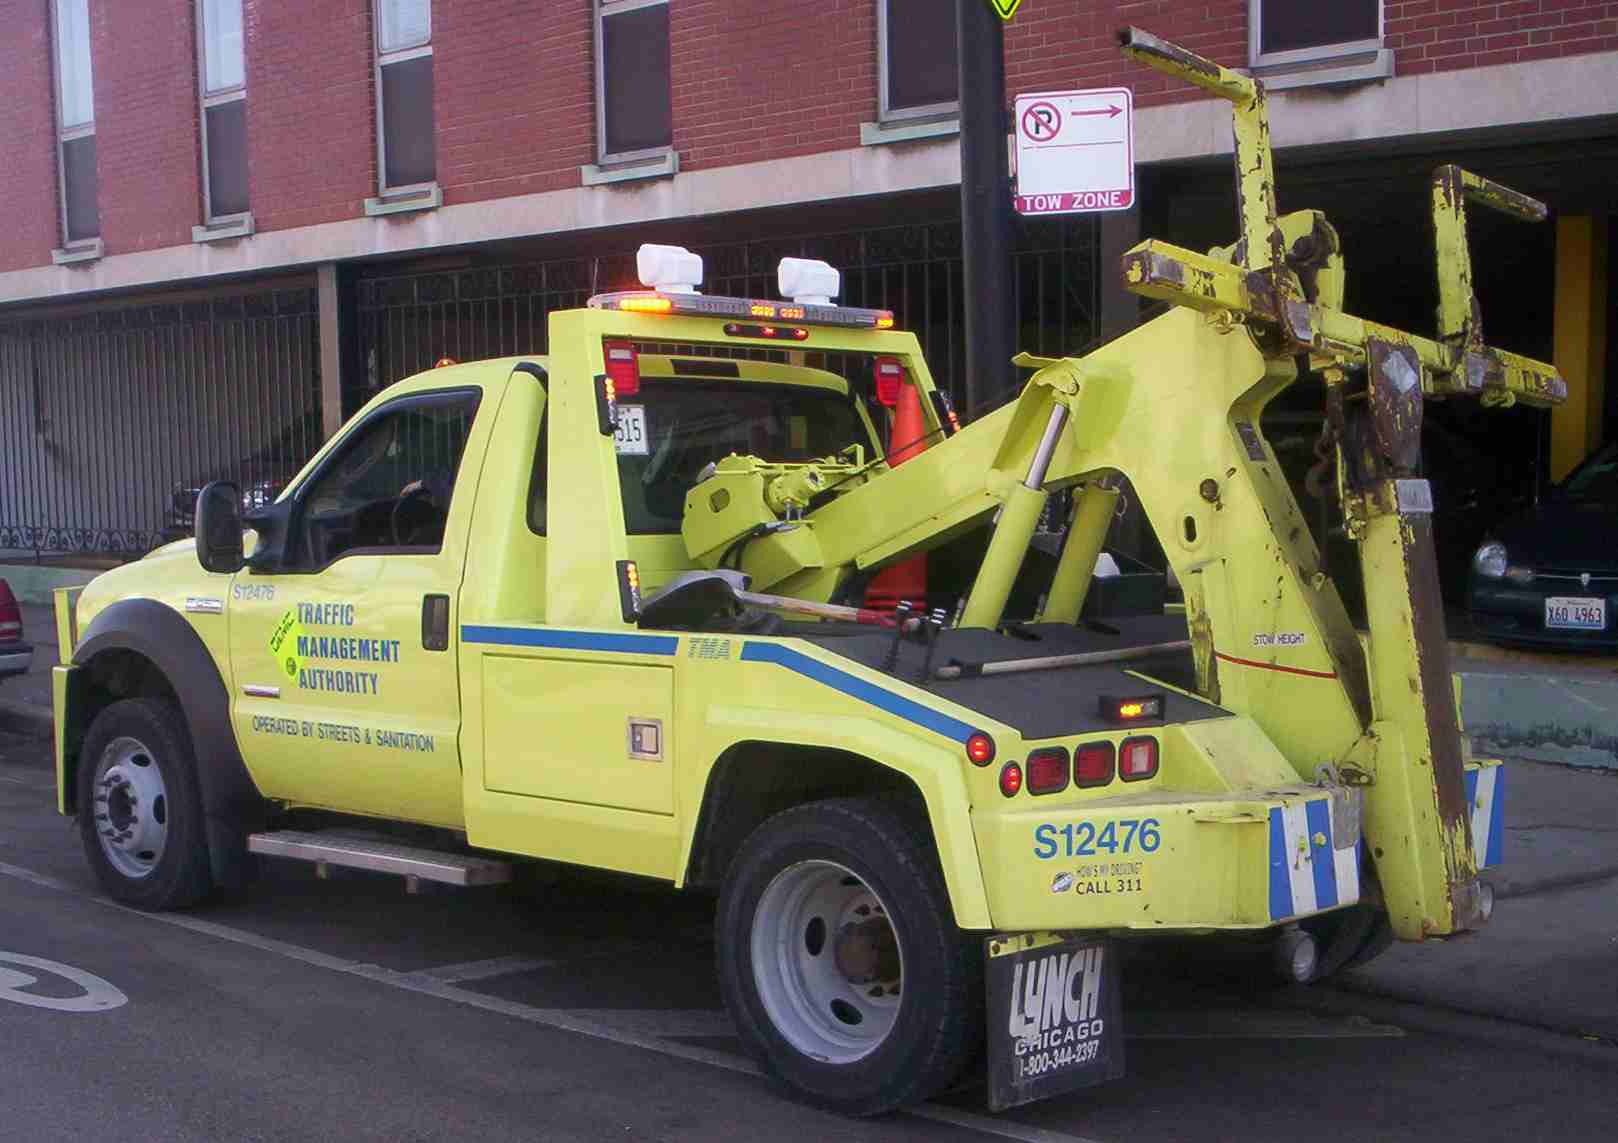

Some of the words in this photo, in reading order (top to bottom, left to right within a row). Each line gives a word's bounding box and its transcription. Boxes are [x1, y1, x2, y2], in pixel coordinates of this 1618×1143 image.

[1023, 195, 1062, 211] TOW
[1072, 191, 1122, 208] ZONE
[297, 603, 354, 625] TRAFFIC
[297, 636, 400, 662] MANAGEMENT
[299, 668, 378, 695] AUTHORITY
[252, 715, 298, 736] OPERATED
[302, 720, 314, 737] BY
[318, 722, 361, 744] STREETS
[365, 728, 372, 744] &
[375, 729, 434, 752] SANITATION
[1033, 818, 1161, 859] S12476
[1075, 880, 1111, 895] CALL
[1117, 879, 1142, 892] 311
[1009, 947, 1103, 1038] LYNCH
[1014, 1019, 1104, 1056] CHICAGO
[1019, 1039, 1100, 1077] 1-800-344-2397
